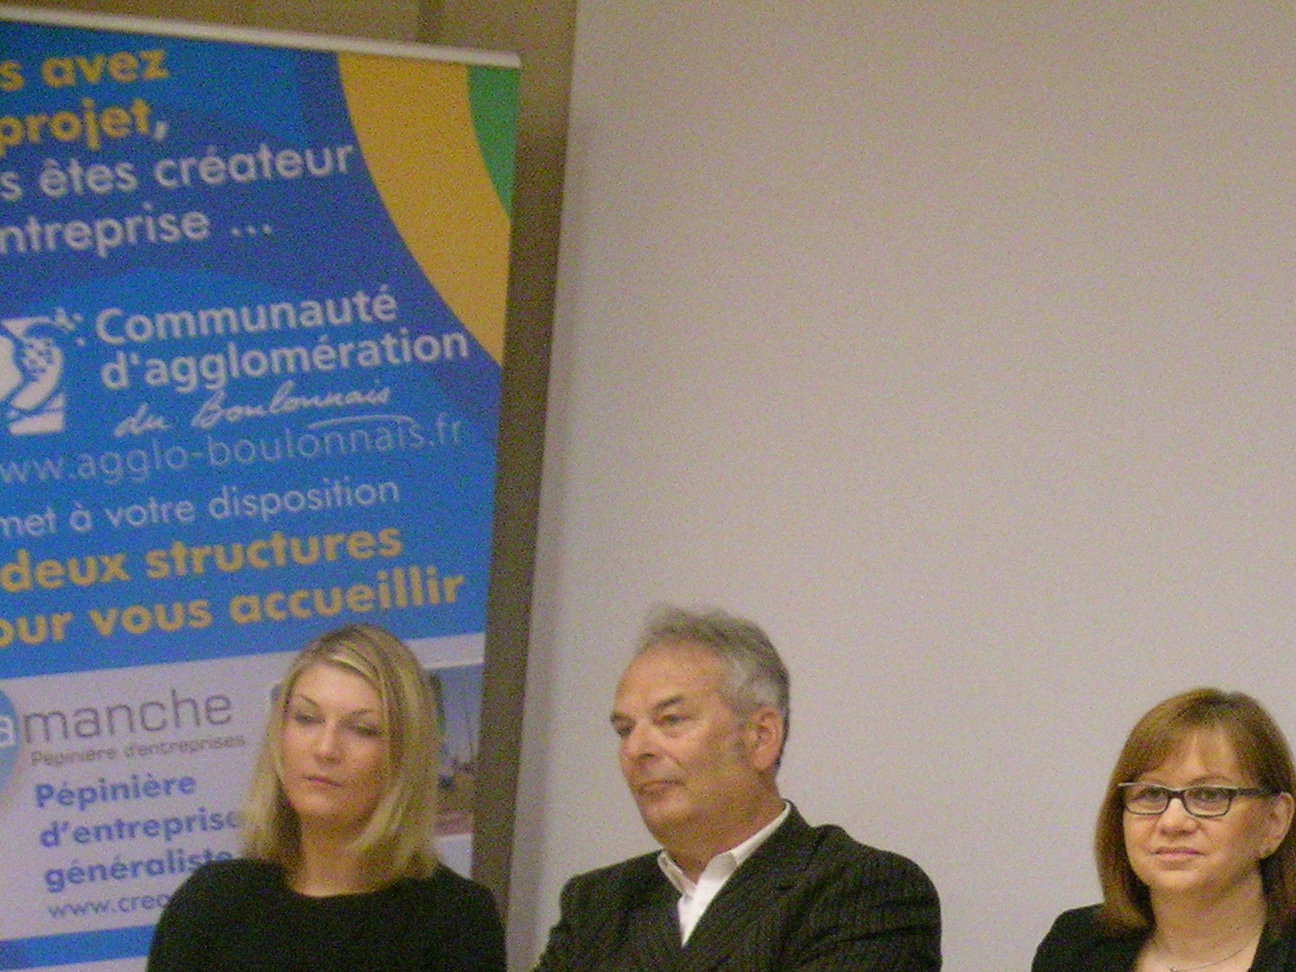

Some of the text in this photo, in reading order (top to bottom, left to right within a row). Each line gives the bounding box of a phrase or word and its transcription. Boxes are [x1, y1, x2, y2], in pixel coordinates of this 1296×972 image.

[41, 48, 170, 88] avez
[39, 157, 139, 199] êtes
[155, 143, 354, 190] créateur
[97, 284, 398, 345] Communauté
[101, 327, 470, 394] d'agglomération
[114, 379, 391, 438] du Boulonnais
[0, 478, 399, 537] met à votre disposition
[0, 528, 404, 593] deux structures
[90, 598, 213, 638] vous
[230, 567, 465, 625] accueillir
[35, 772, 196, 812] Pépinière
